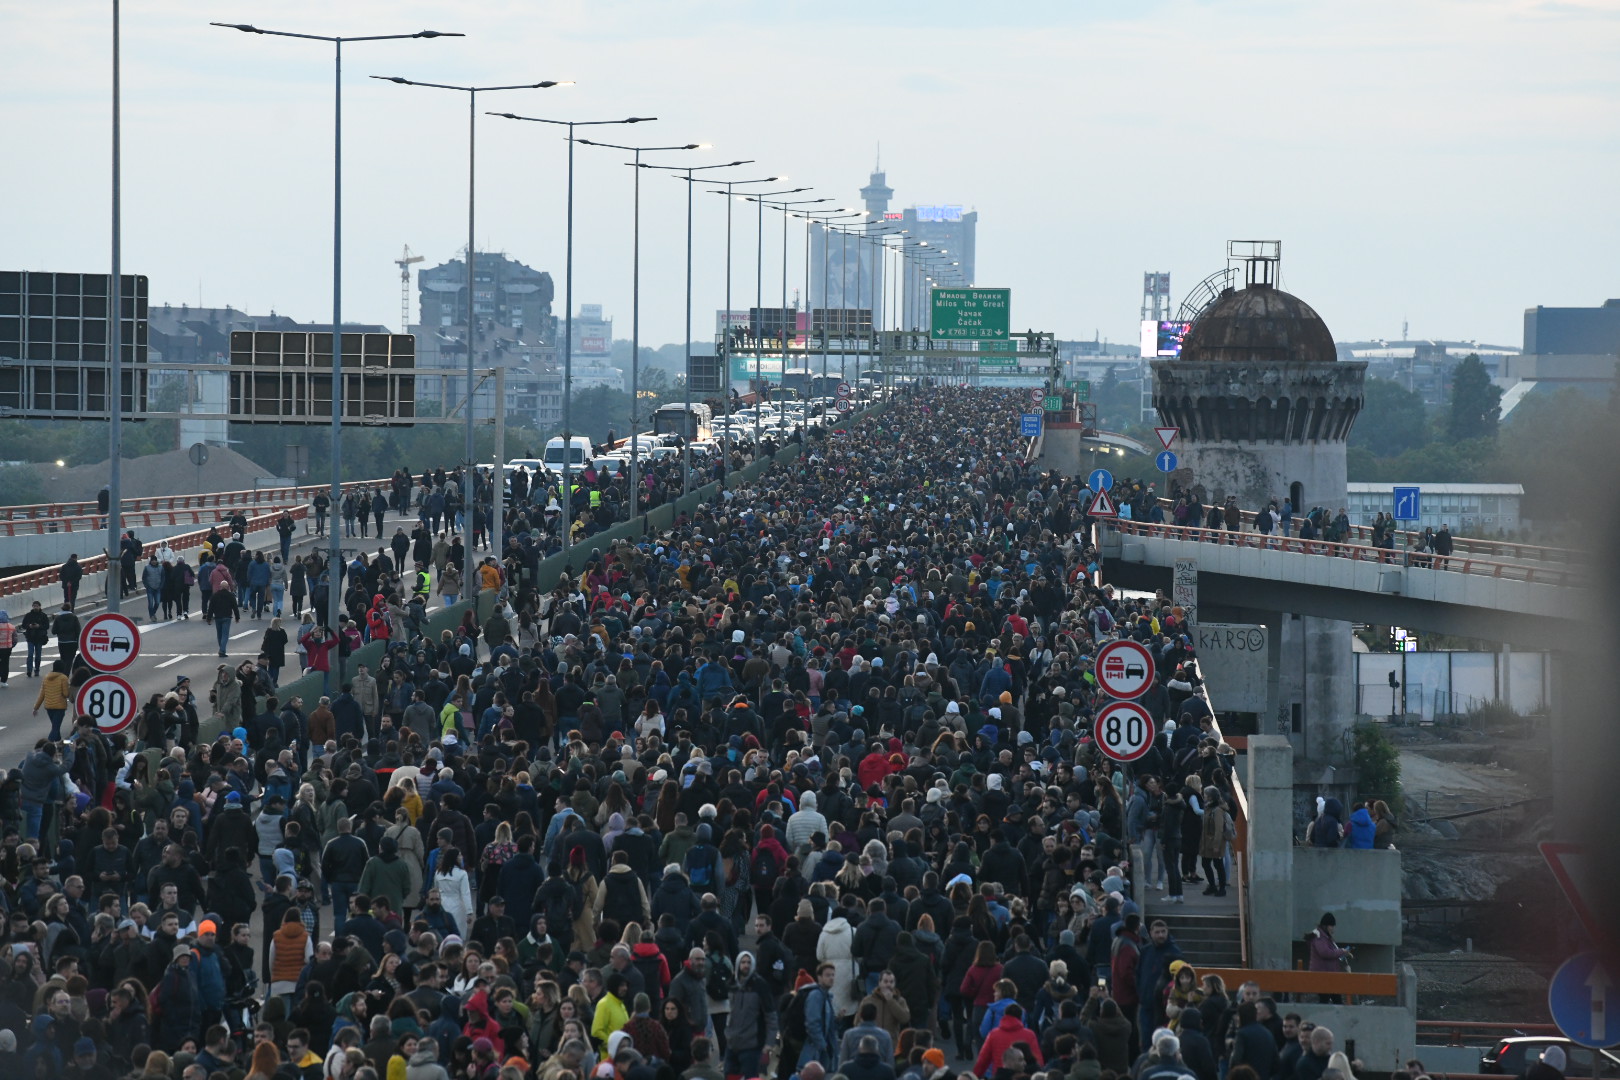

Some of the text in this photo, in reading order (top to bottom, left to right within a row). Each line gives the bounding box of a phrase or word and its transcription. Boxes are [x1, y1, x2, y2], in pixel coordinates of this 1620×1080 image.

[839, 401, 848, 410] 80
[1034, 408, 1043, 416] 80
[89, 689, 125, 719] 80
[1105, 716, 1143, 747] 80
